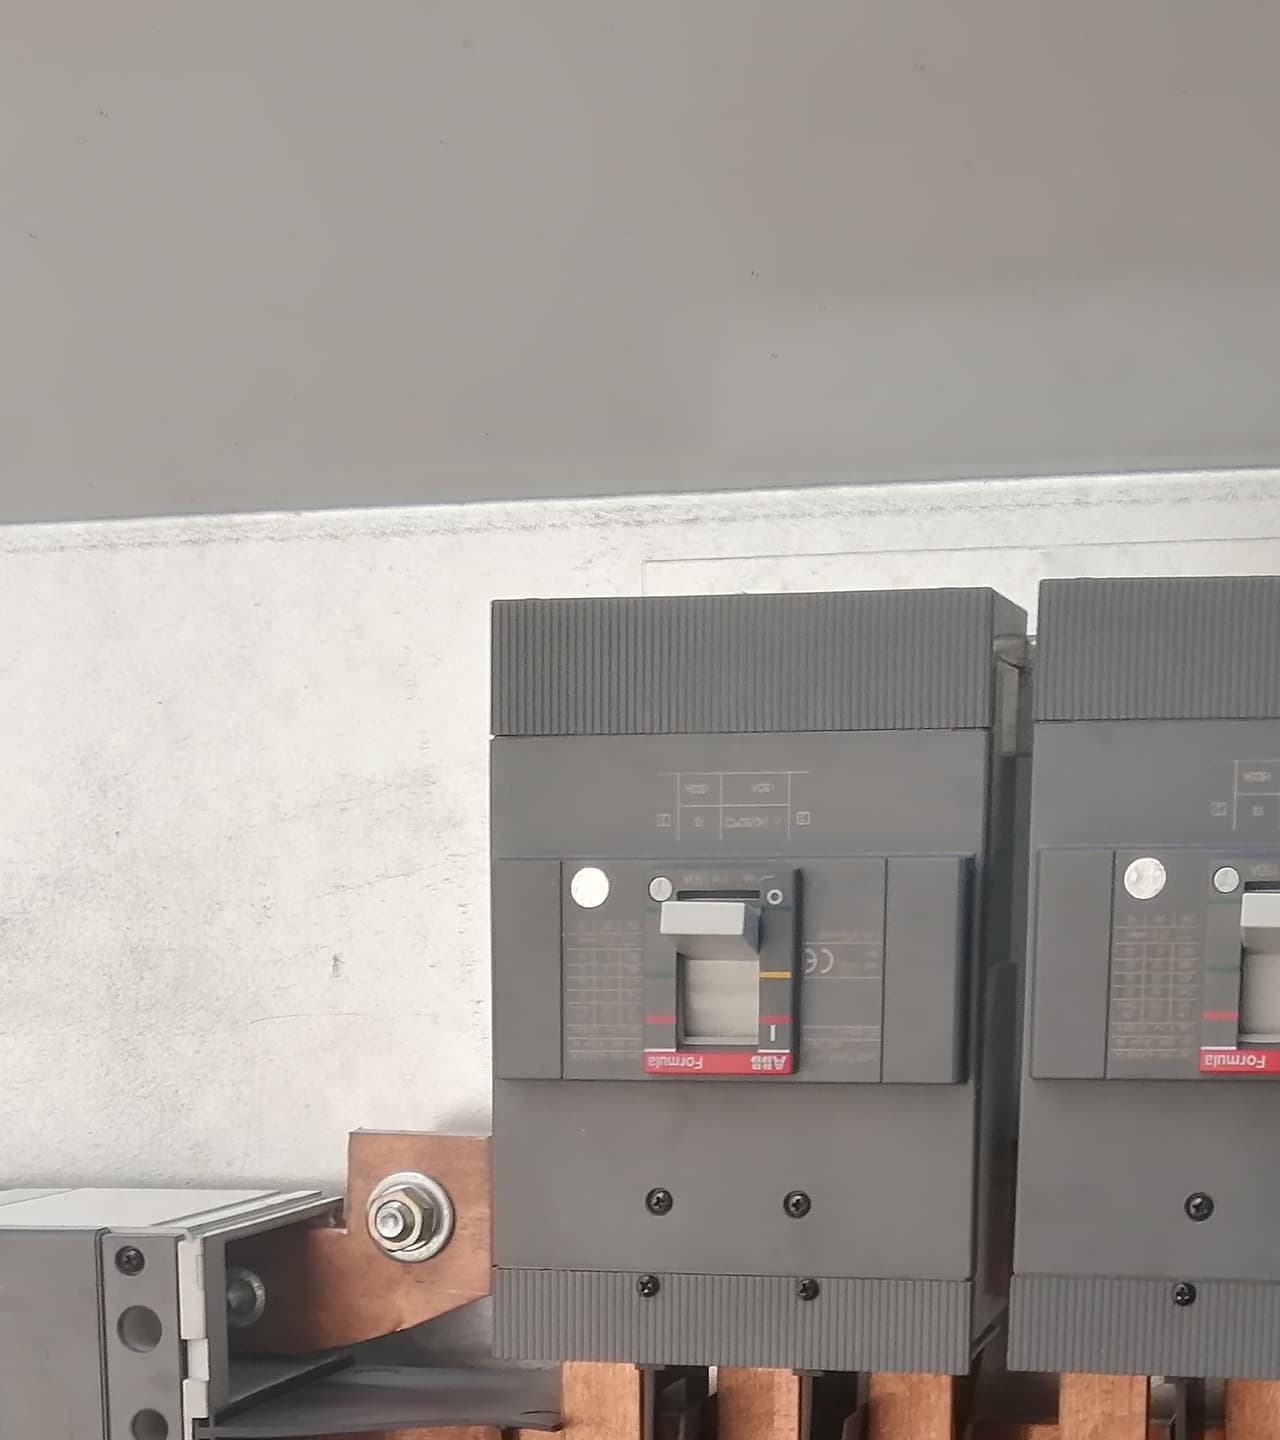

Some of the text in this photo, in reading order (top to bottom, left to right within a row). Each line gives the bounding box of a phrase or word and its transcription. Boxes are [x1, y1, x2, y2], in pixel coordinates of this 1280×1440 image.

[647, 1055, 788, 1071] ABB Formula
[1204, 1054, 1267, 1069] Formula
